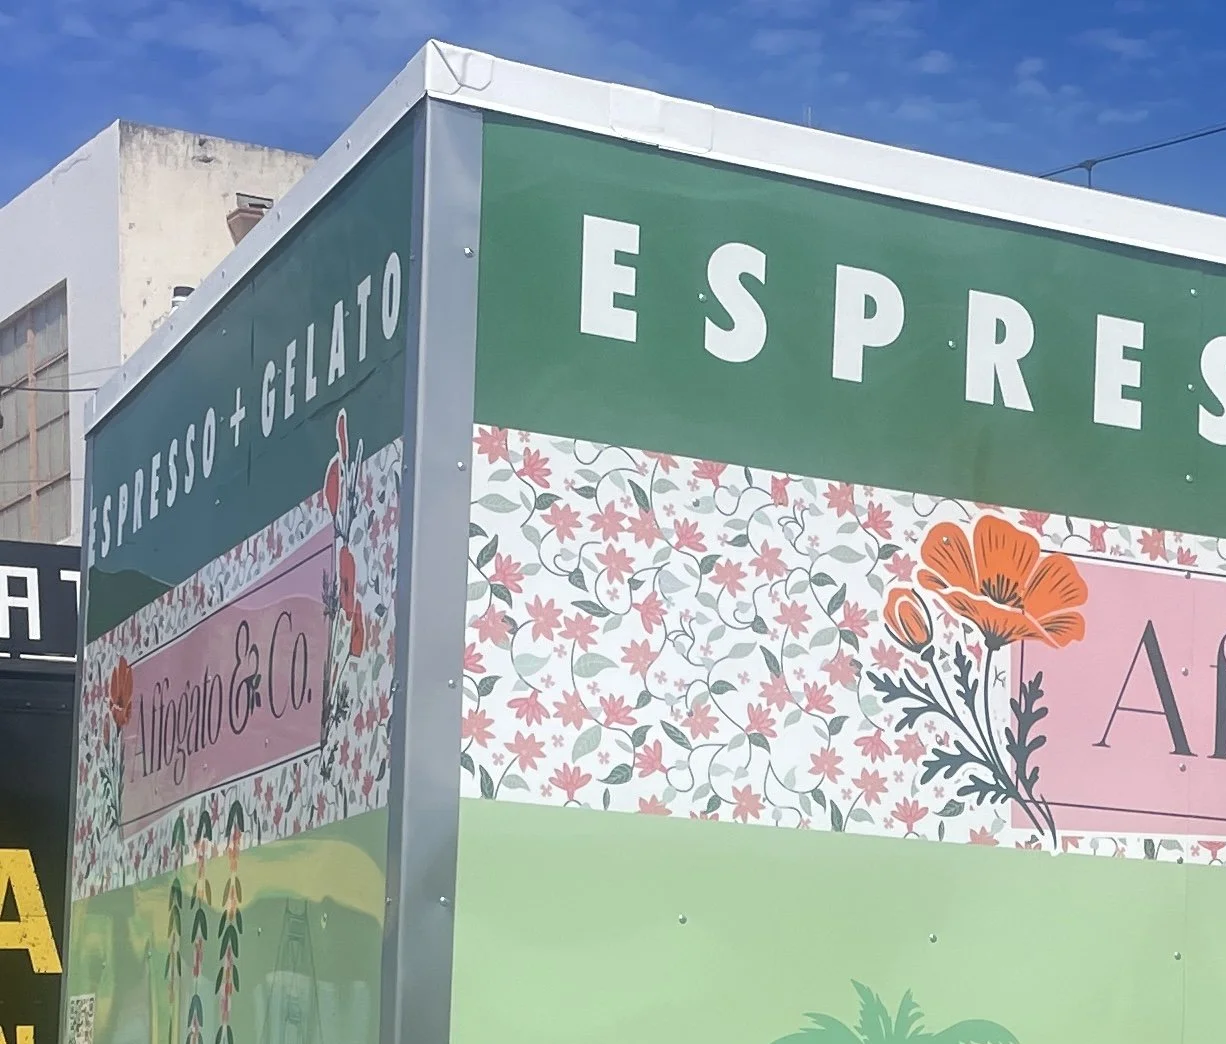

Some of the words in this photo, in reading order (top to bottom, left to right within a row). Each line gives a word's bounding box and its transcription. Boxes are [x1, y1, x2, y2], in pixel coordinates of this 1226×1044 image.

[87, 406, 216, 570] ESPRESSO
[229, 386, 247, 447] +
[260, 251, 403, 438] GELATO
[130, 664, 223, 786] Affogato
[228, 619, 262, 735] &
[268, 610, 312, 719] Co.
